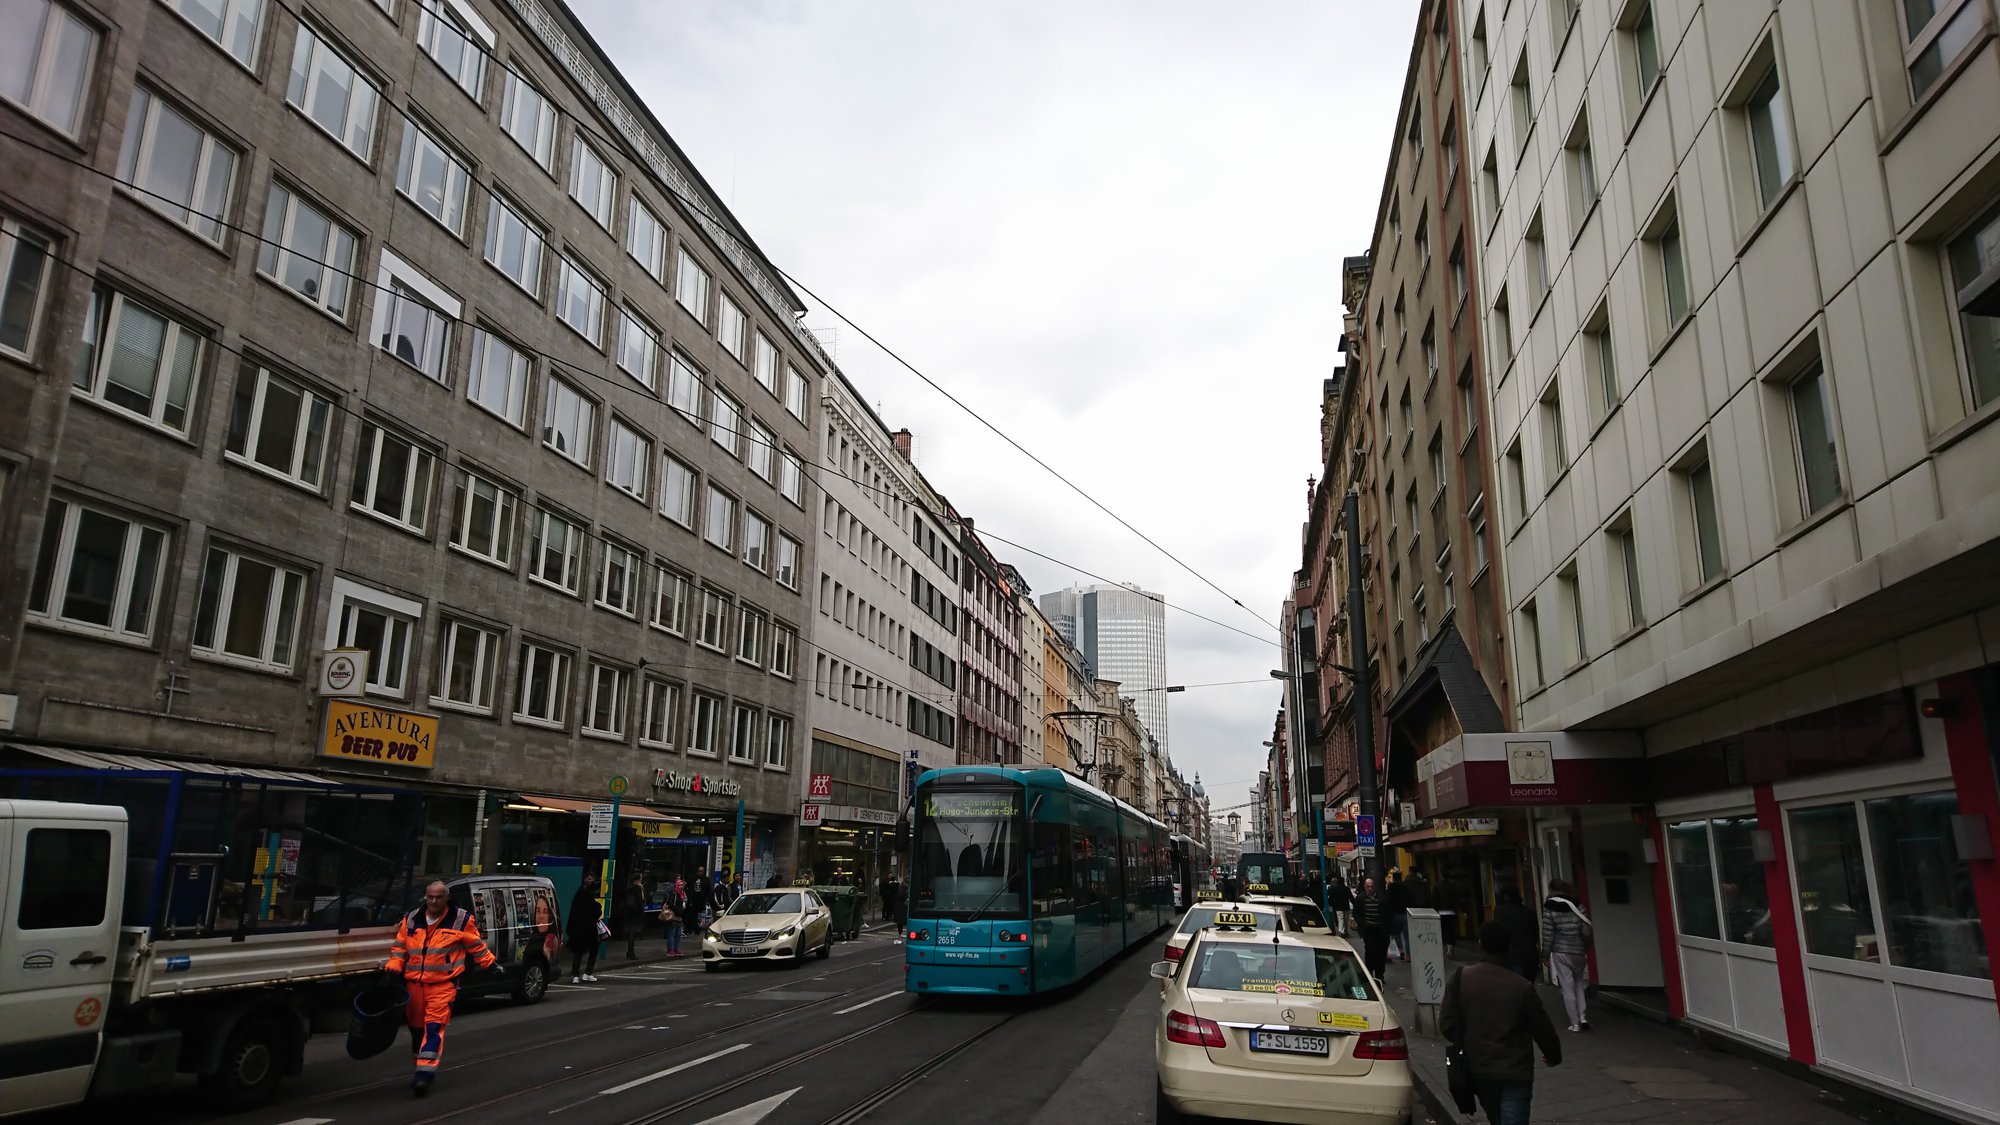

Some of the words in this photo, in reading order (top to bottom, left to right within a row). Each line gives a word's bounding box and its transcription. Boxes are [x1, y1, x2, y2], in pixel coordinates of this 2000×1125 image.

[334, 711, 430, 751] AVENTURA
[341, 735, 384, 759] BEER
[387, 741, 418, 762] PUB
[693, 772, 701, 792] &
[702, 776, 741, 796] Sportsbar
[1509, 787, 1558, 797] Leonardo
[924, 800, 938, 816] 12
[883, 812, 895, 823] STORE
[641, 820, 661, 834] KIOSK
[1359, 836, 1374, 844] TAXI
[1221, 913, 1250, 923] TAXI
[938, 936, 949, 944] 265
[1258, 1033, 1266, 1047] F
[1275, 1035, 1291, 1049] SL
[1294, 1037, 1325, 1051] 1559
